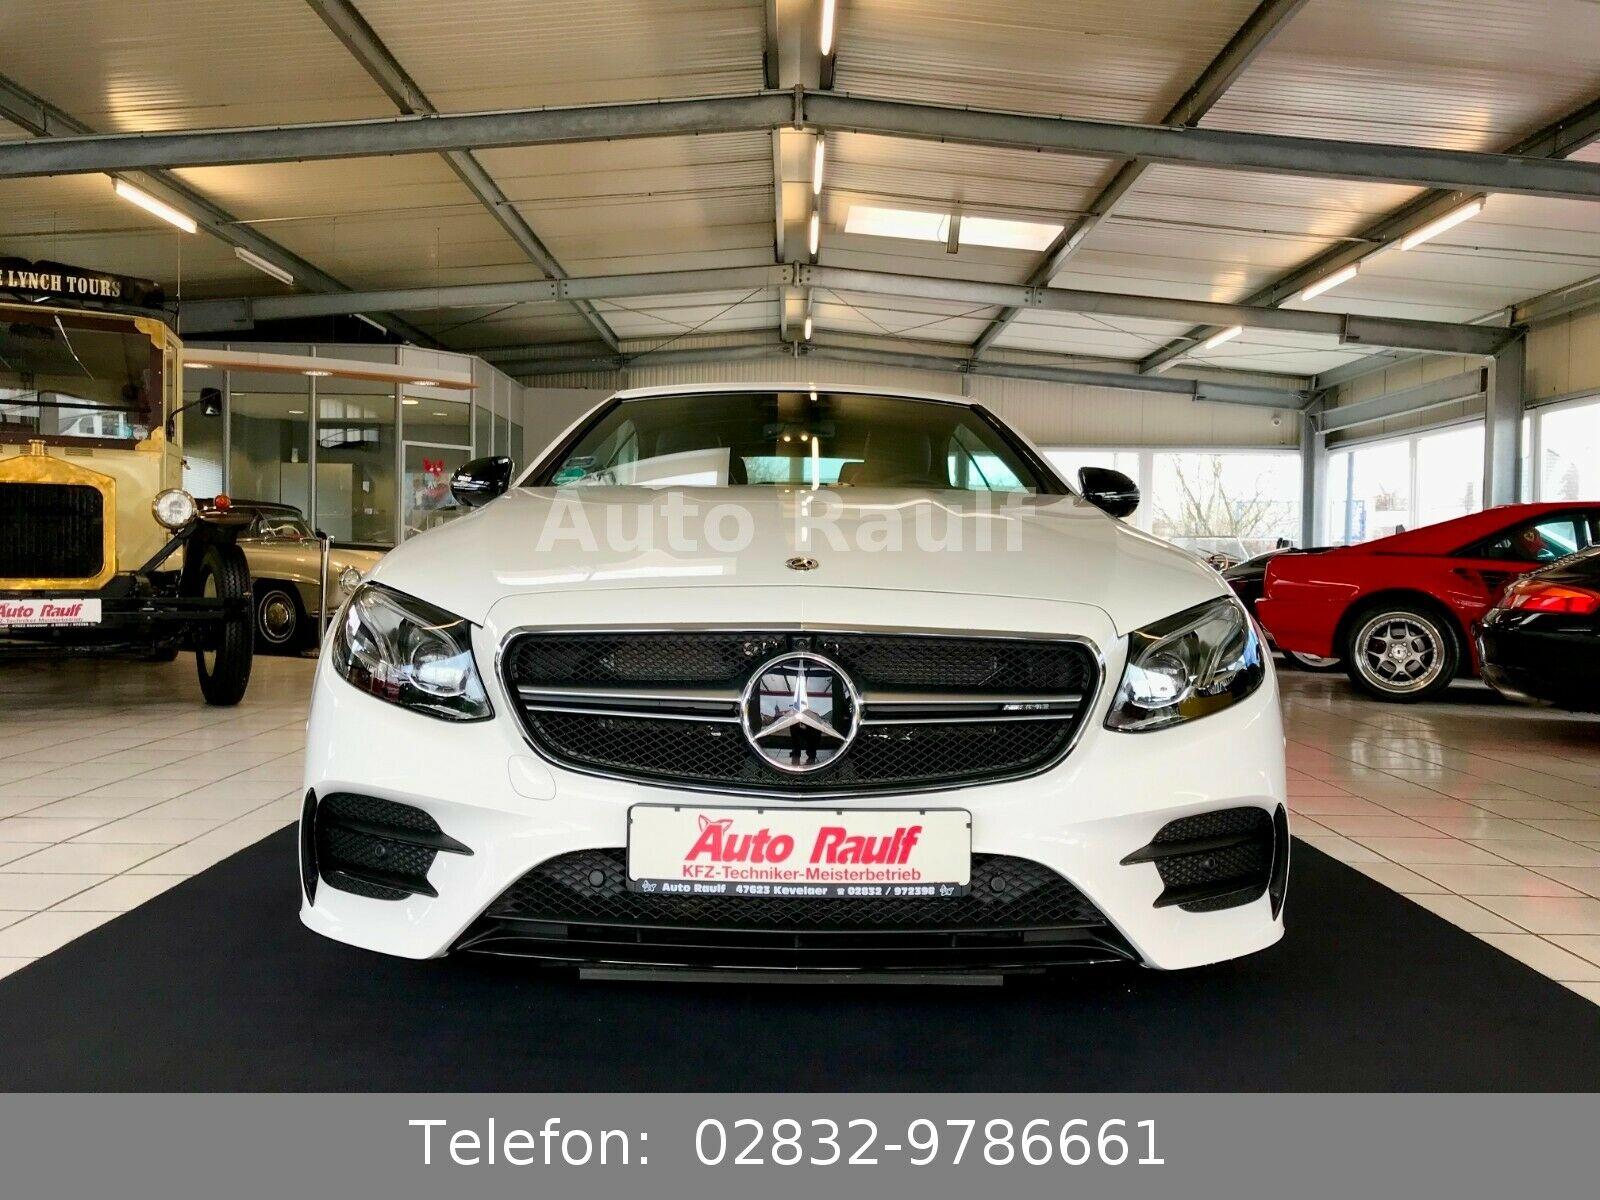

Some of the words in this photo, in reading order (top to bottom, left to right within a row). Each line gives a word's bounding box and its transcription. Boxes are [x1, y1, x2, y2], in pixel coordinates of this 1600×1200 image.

[8, 270, 61, 292] LYNCH
[66, 276, 121, 298] TOURS
[40, 603, 83, 617] Raulf
[684, 823, 795, 864] Auto
[809, 825, 923, 864] Raulf
[682, 864, 921, 881] KFZ-Techniker-Meisterbetrieb
[661, 882, 691, 893] Auto
[693, 883, 726, 894] Raulf
[735, 884, 770, 895] 47623
[847, 886, 883, 897] 02832
